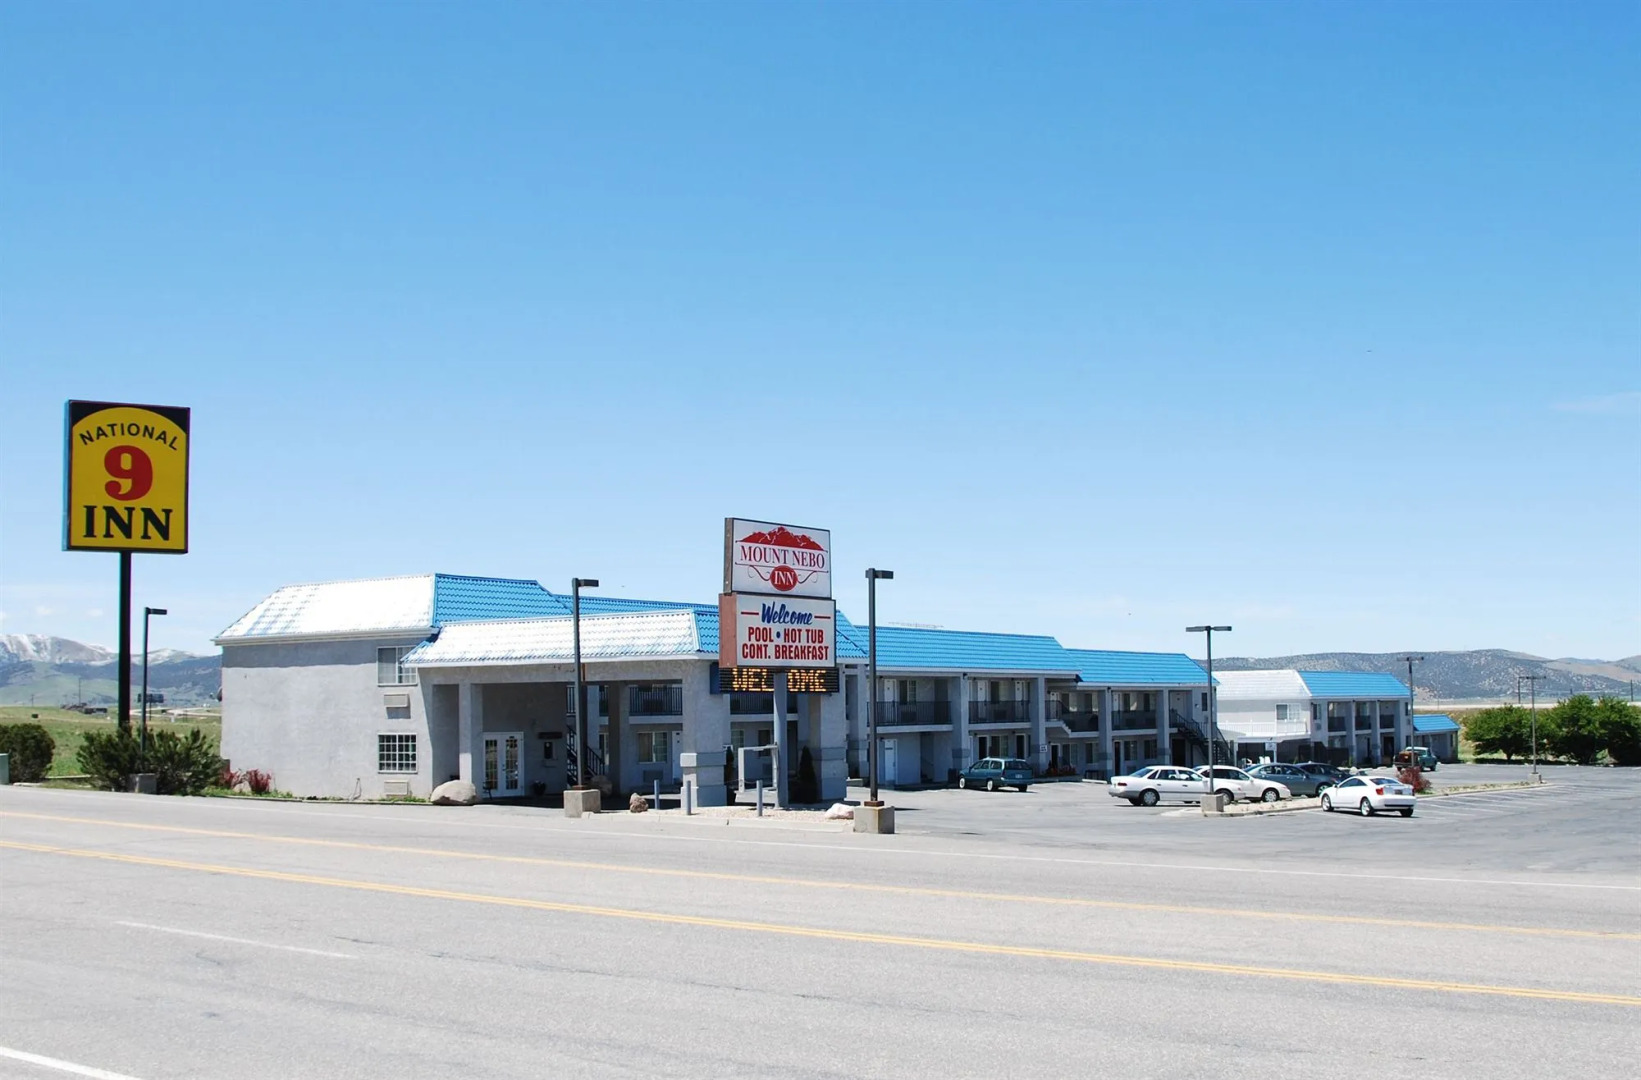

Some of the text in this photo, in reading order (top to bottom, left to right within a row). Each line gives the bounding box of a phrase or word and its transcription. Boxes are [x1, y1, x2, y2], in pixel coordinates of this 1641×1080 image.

[79, 423, 178, 450] NATIONAL
[104, 445, 153, 501] 9
[83, 505, 173, 541] INN
[740, 545, 825, 568] MOUNT NEBO
[774, 571, 794, 585] INN
[761, 601, 813, 625] Welcome
[748, 627, 824, 643] POOL HOT TUB
[741, 643, 829, 660] CONT. BREAKFAST
[732, 668, 826, 692] WELOME
